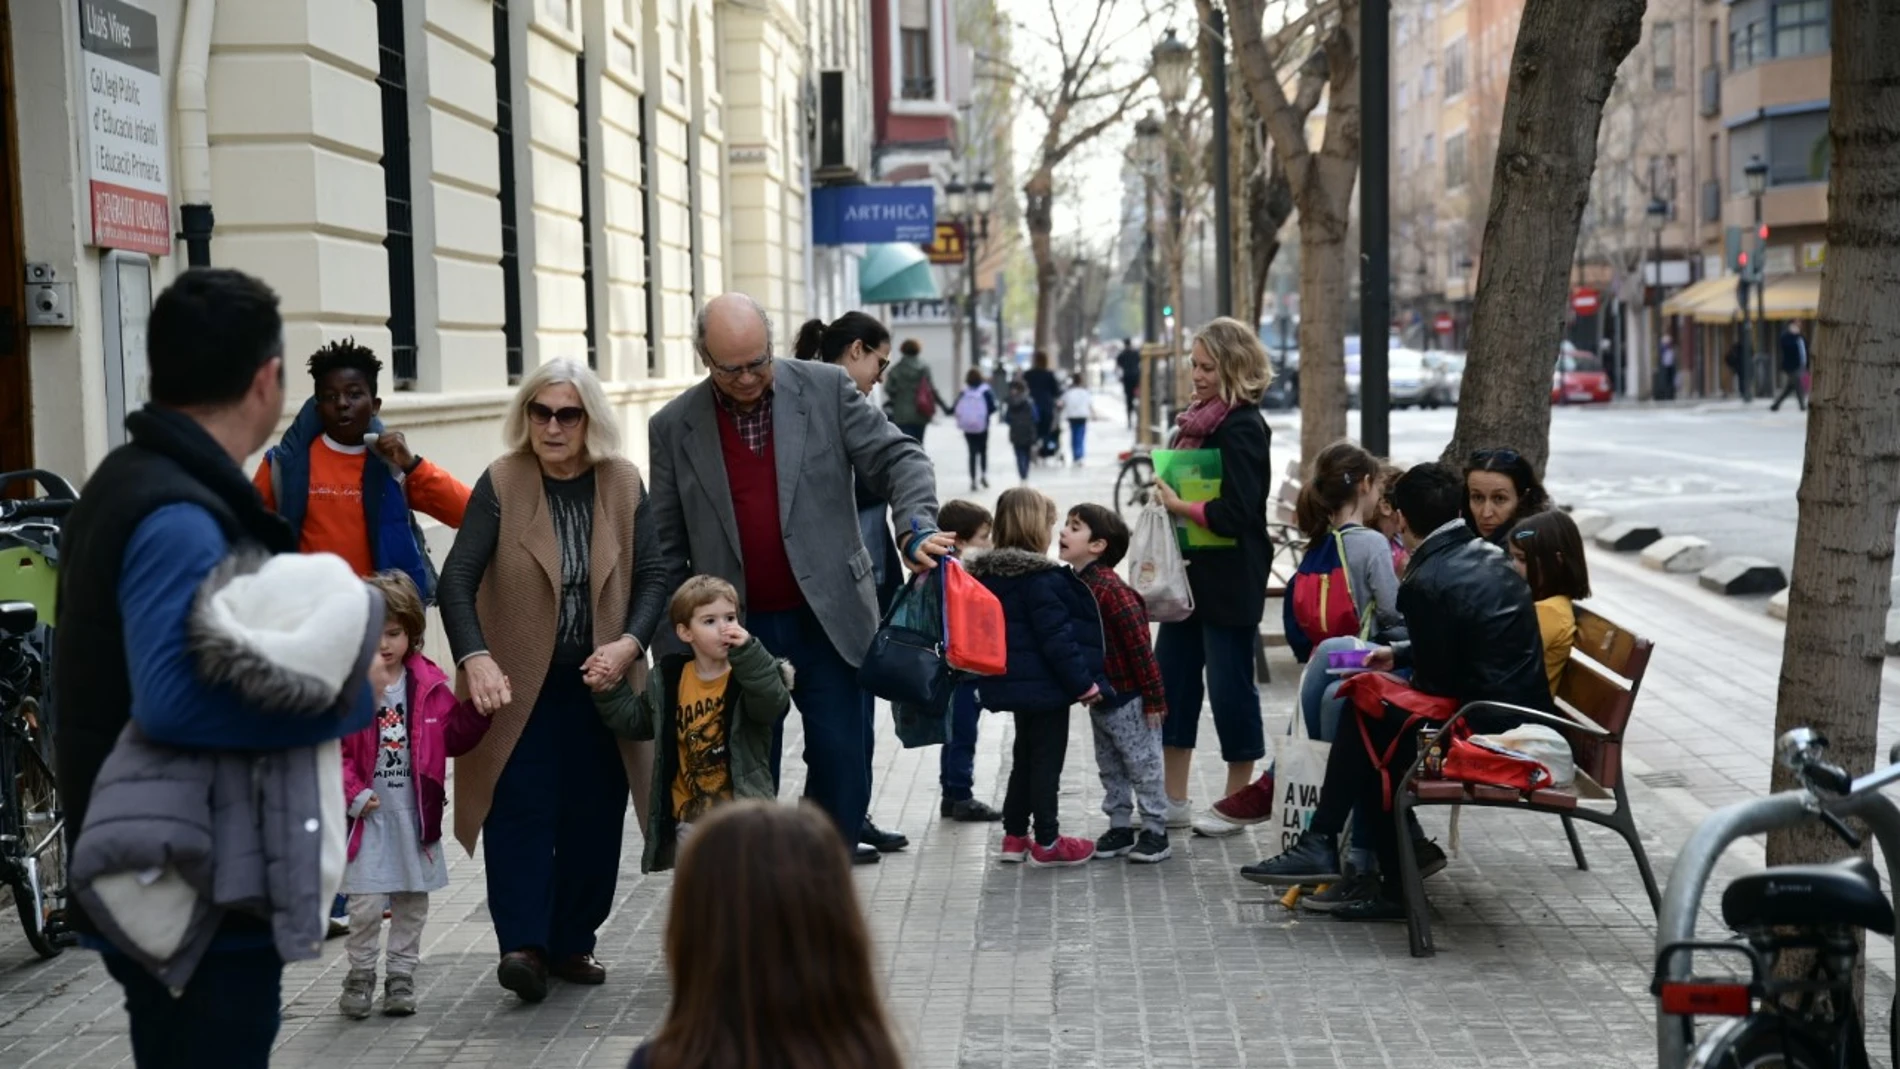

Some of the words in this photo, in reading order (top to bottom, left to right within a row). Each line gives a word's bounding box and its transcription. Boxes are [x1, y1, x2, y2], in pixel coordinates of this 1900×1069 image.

[844, 204, 930, 221] ARTHICA
[1284, 782, 1295, 806] A
[1283, 807, 1300, 829] LA
